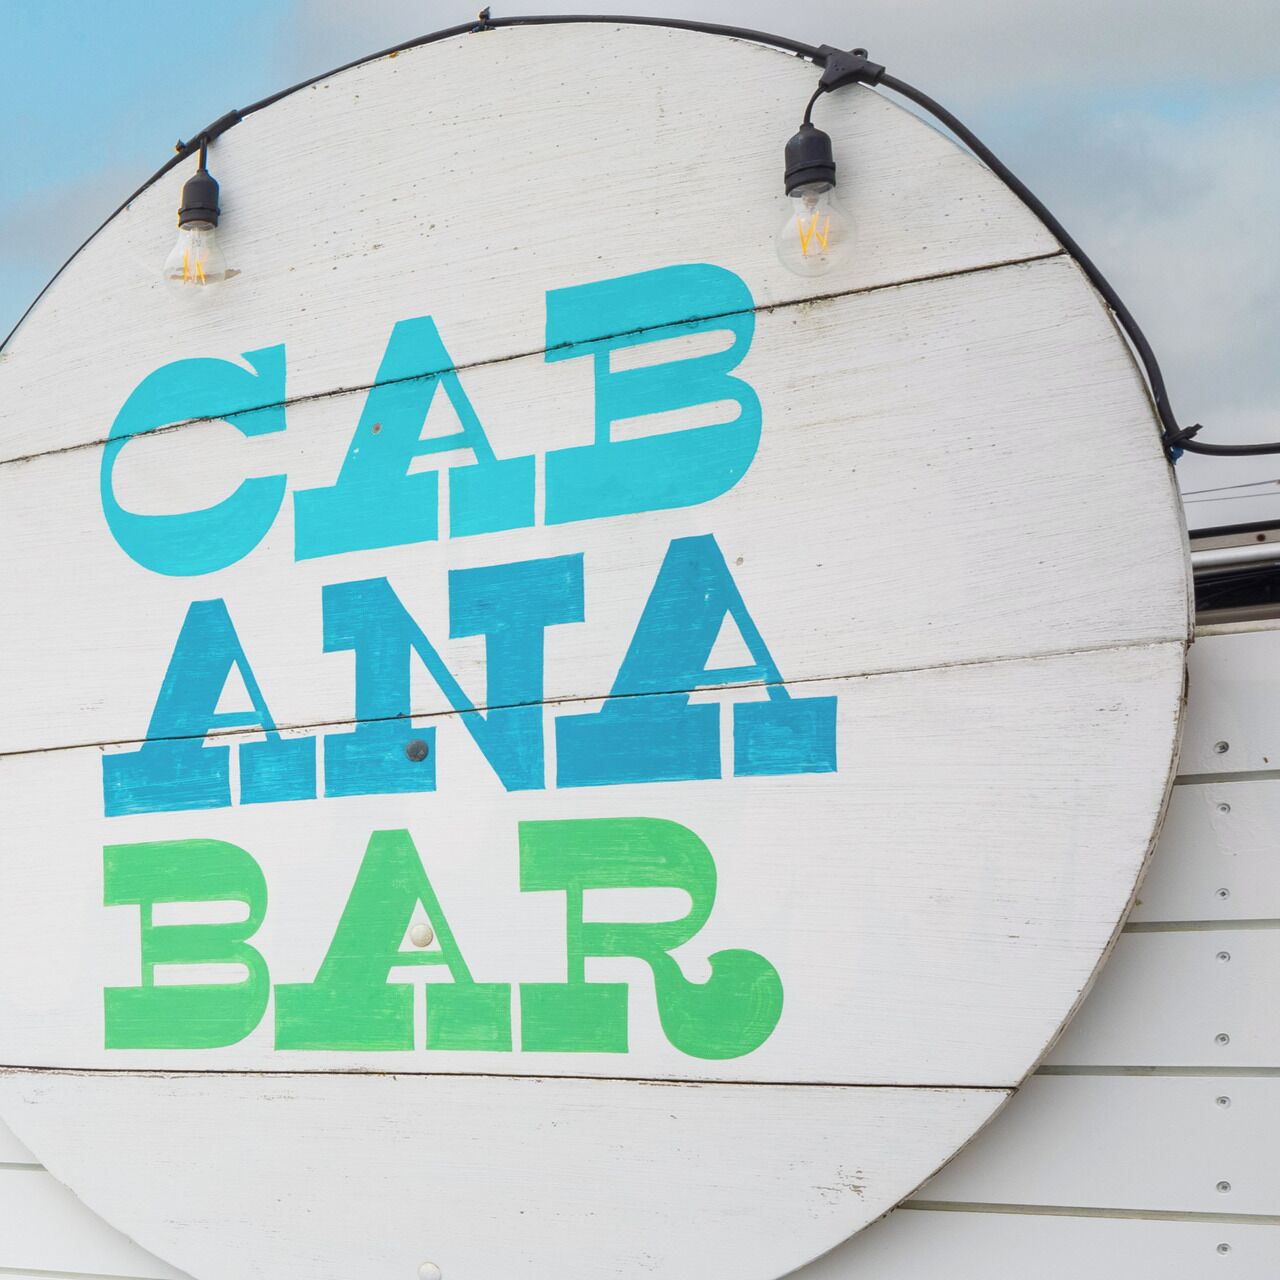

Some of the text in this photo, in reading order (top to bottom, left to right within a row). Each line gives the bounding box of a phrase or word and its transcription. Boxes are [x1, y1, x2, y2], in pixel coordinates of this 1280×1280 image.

[100, 262, 763, 577] CAB
[102, 533, 839, 818] ANA
[103, 816, 784, 1060] BAR
